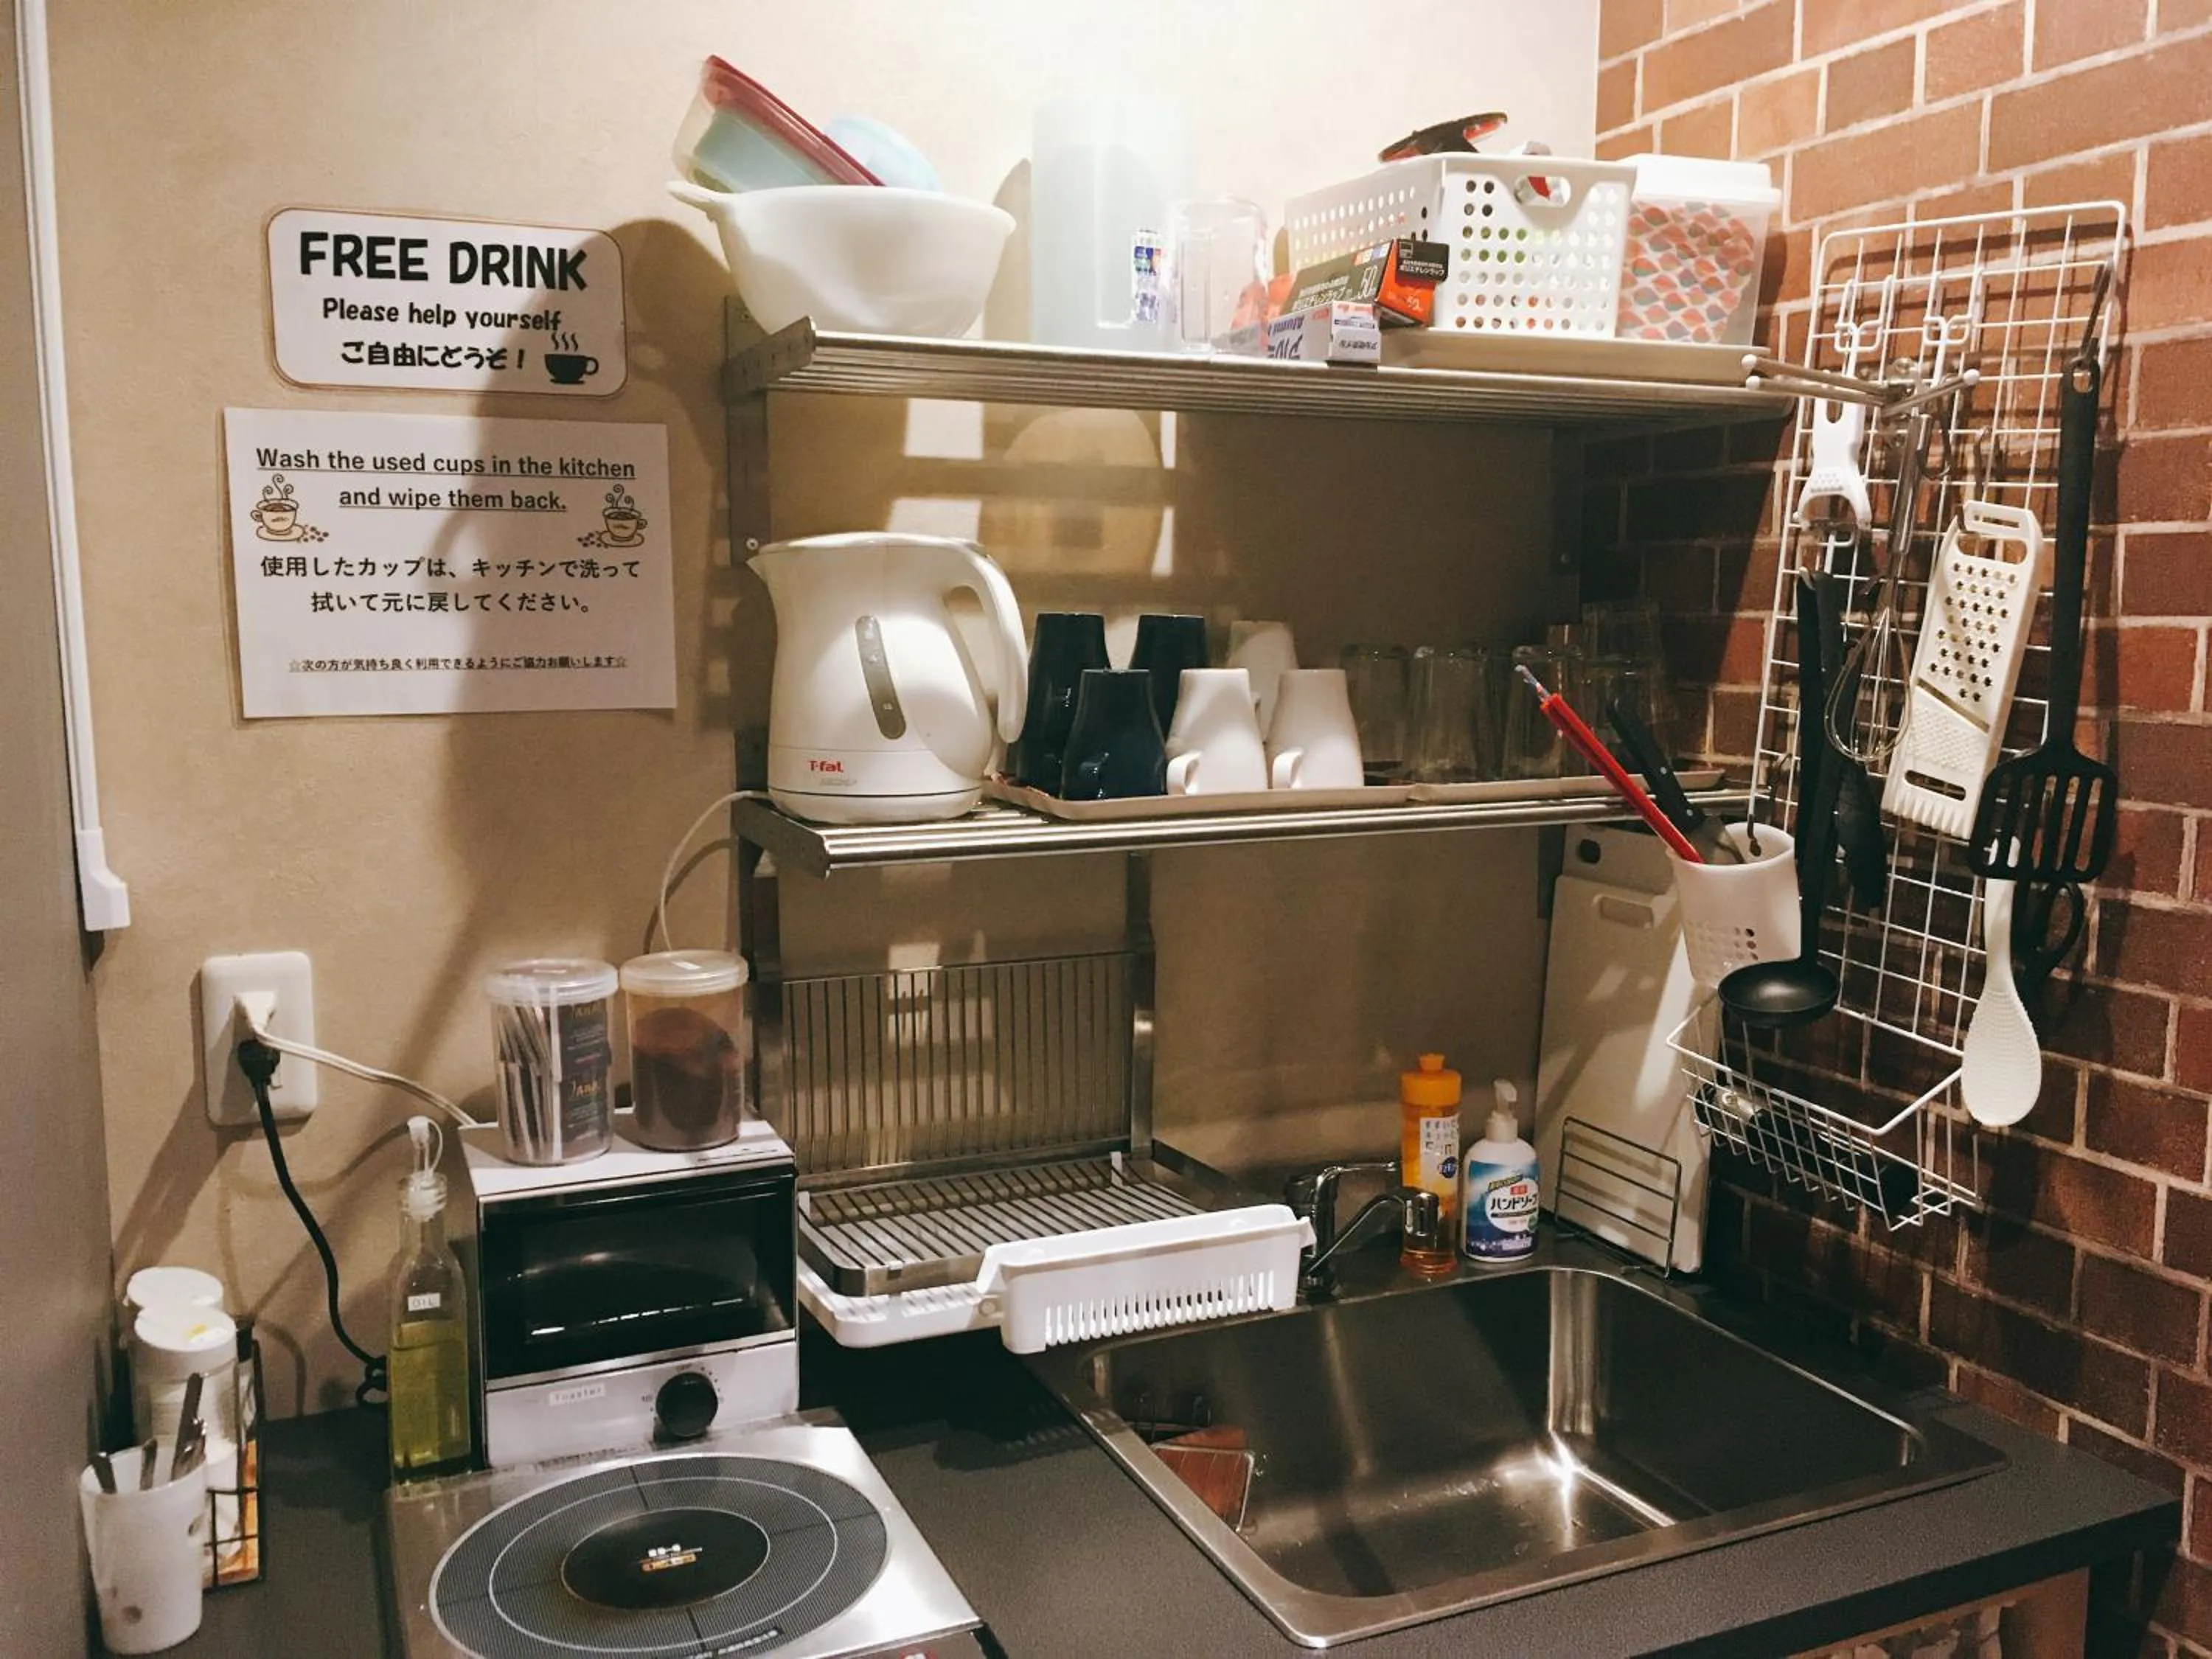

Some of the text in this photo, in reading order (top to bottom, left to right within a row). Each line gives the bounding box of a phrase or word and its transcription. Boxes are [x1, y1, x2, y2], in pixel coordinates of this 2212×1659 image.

[300, 232, 588, 291] FREE DRINK
[323, 298, 562, 331] Please help yourself
[341, 341, 525, 369] ご自由にどうぞ！
[257, 448, 636, 478] Wash the used cups in the kitchen
[339, 487, 567, 510] and wipe them back.
[260, 554, 640, 579] 使用したカップは、キッチンで洗って
[311, 591, 590, 613] 拭いて元に戻してください。
